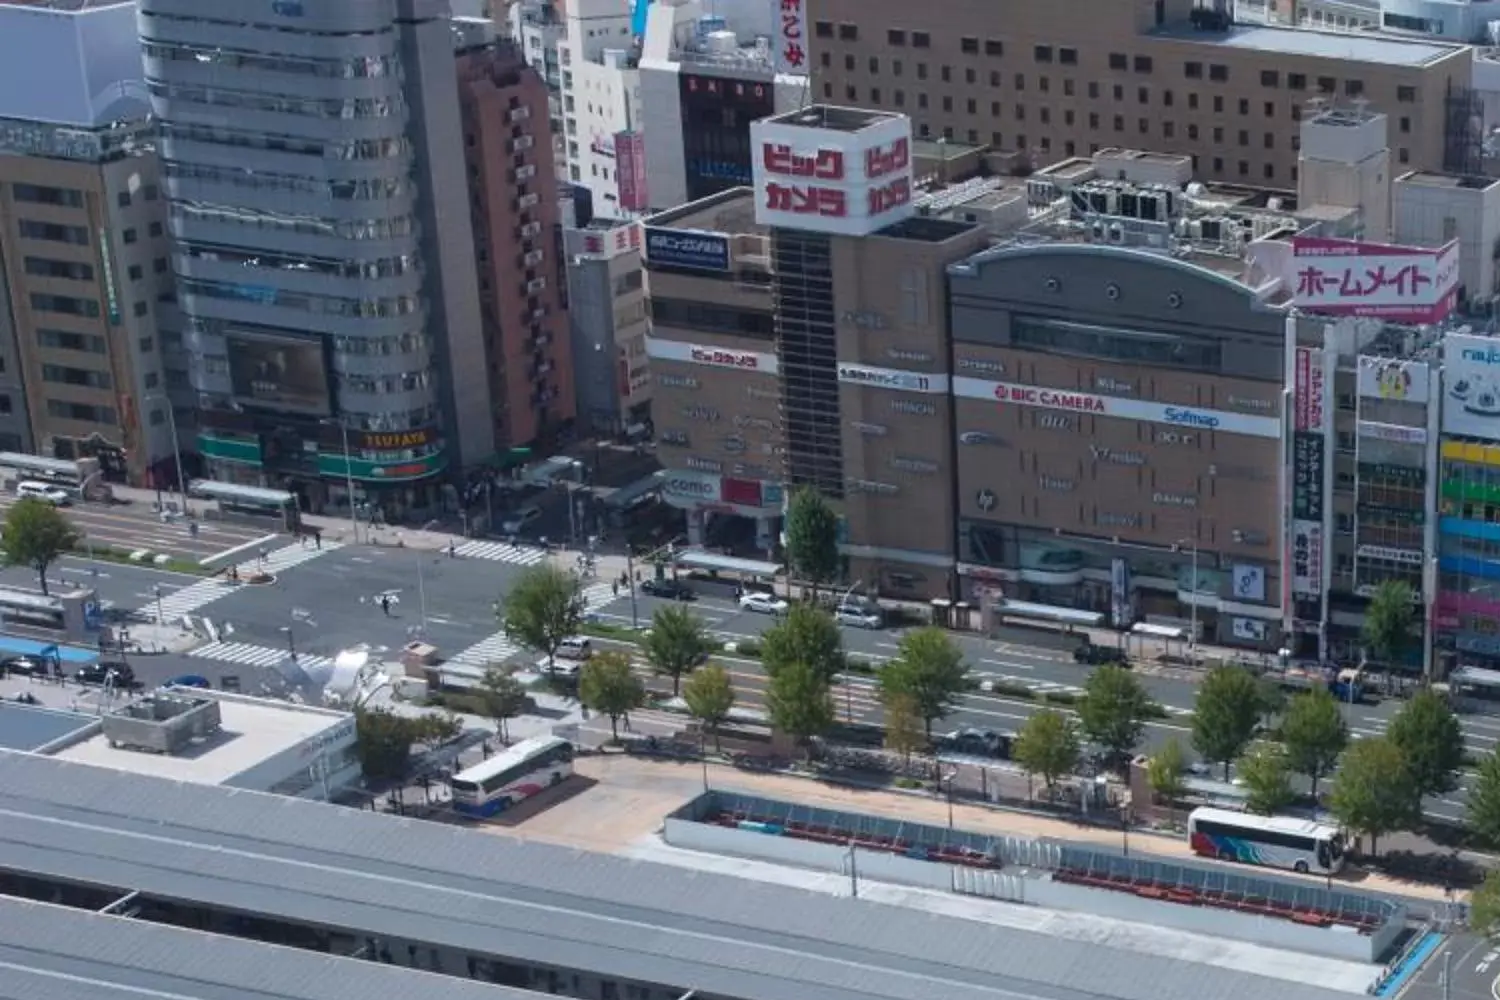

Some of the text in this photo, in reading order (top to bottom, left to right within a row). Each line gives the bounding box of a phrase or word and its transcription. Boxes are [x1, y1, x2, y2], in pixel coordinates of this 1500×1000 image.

[763, 143, 843, 179] ビック
[866, 136, 909, 178] ビック
[766, 181, 846, 218] カメラ
[869, 176, 910, 216] カメラ
[1297, 265, 1431, 297] ホームメイト
[691, 348, 758, 367] ビックカメラ
[1011, 387, 1105, 412] BIC CAMERA
[1164, 407, 1220, 427] Sofmap
